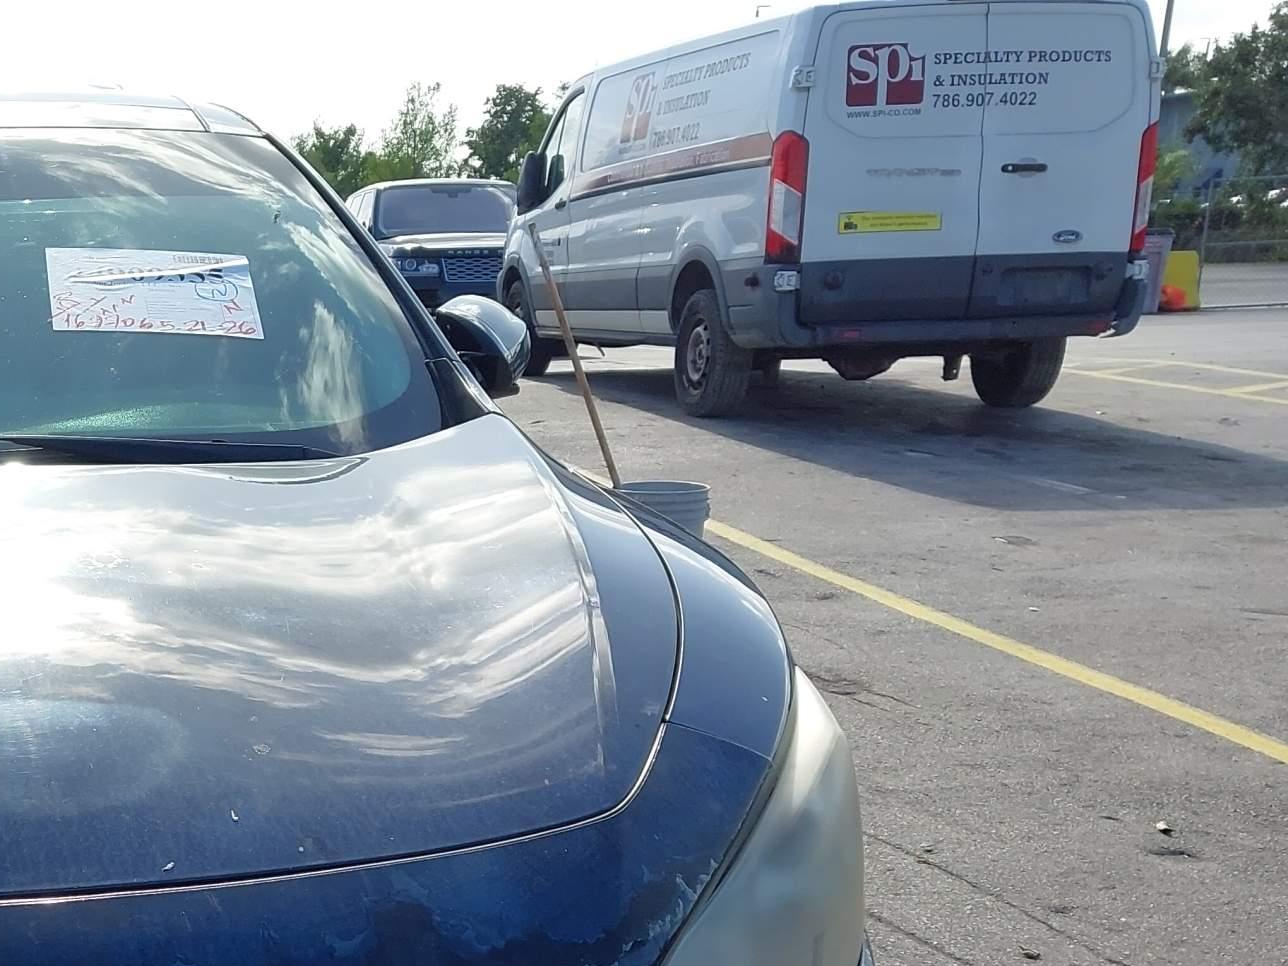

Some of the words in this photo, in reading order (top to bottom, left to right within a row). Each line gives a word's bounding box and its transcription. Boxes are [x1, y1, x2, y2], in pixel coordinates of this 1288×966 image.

[934, 51, 1023, 65] SPECIALTY
[1028, 49, 1112, 63] PRODUCTS
[933, 75, 945, 87] &
[949, 72, 1050, 87] INSULATION
[932, 91, 1037, 108] 786.907.4022
